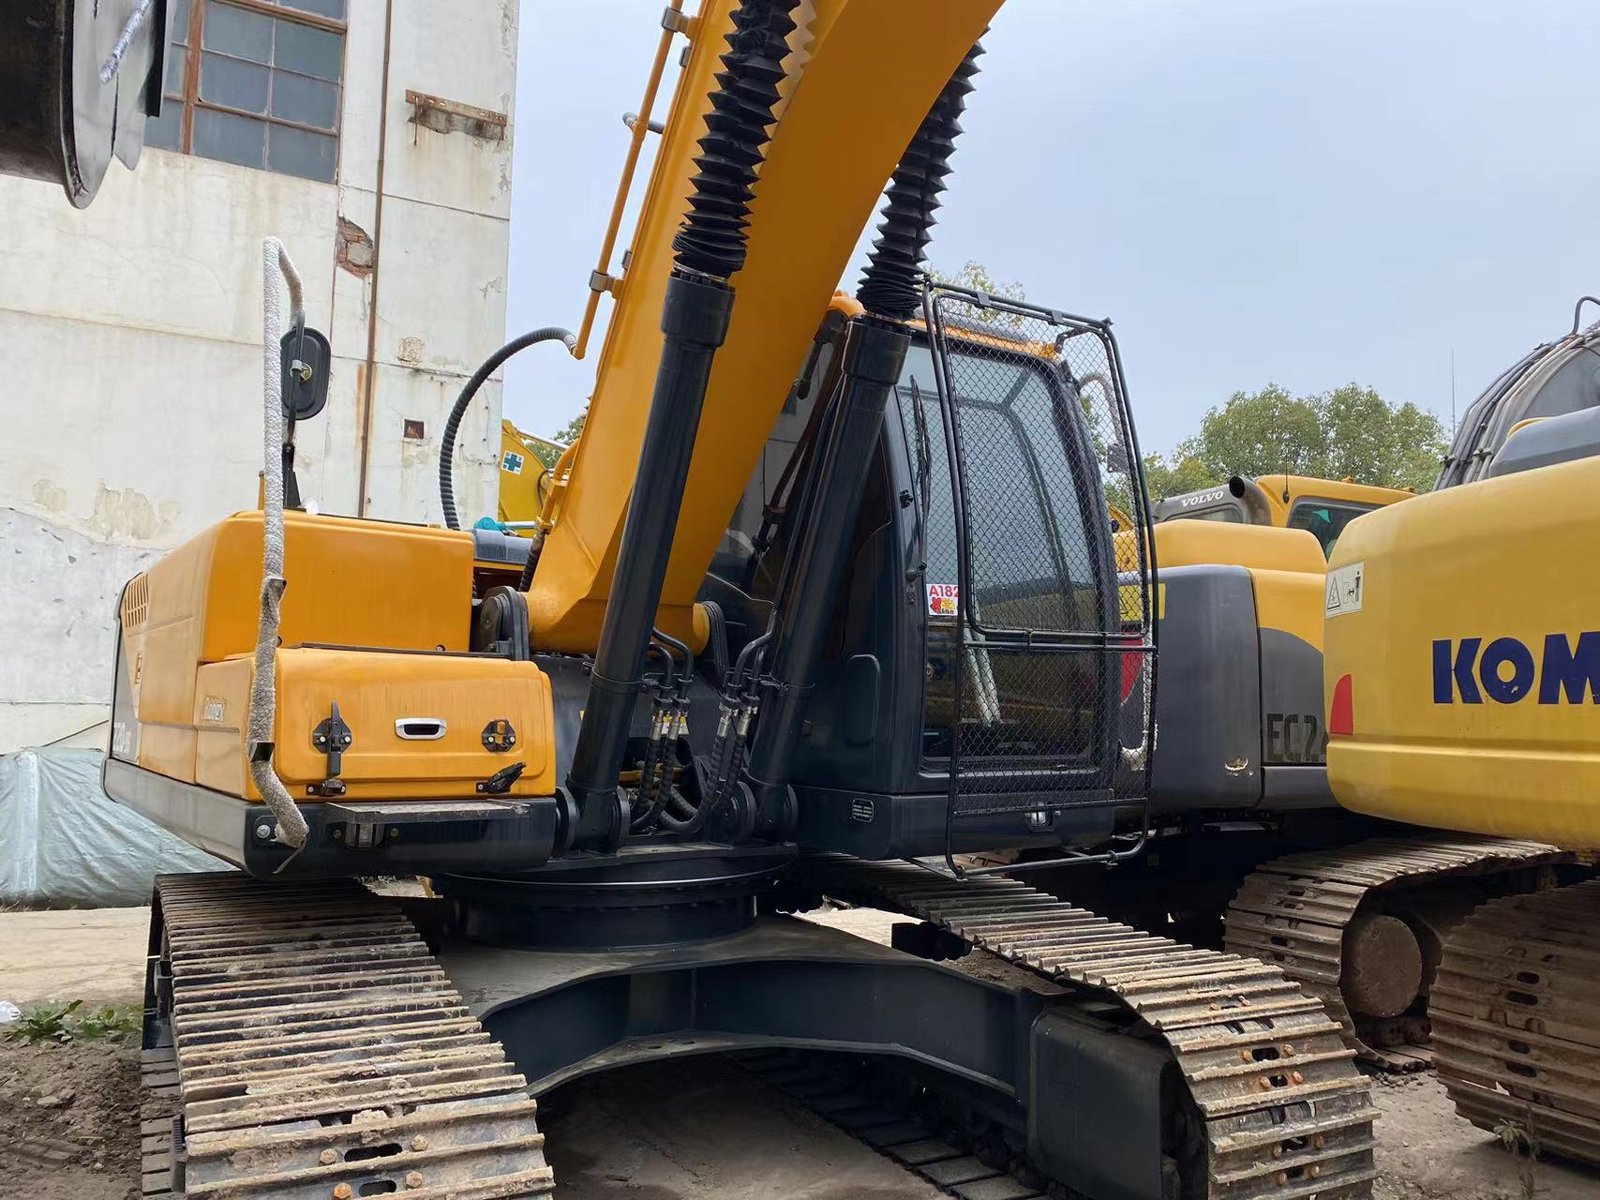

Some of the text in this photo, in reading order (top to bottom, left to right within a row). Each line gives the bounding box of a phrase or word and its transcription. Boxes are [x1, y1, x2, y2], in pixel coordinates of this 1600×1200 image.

[1182, 491, 1224, 507] VOLVO
[1432, 631, 1600, 704] KOM
[1266, 713, 1327, 762] EC2
